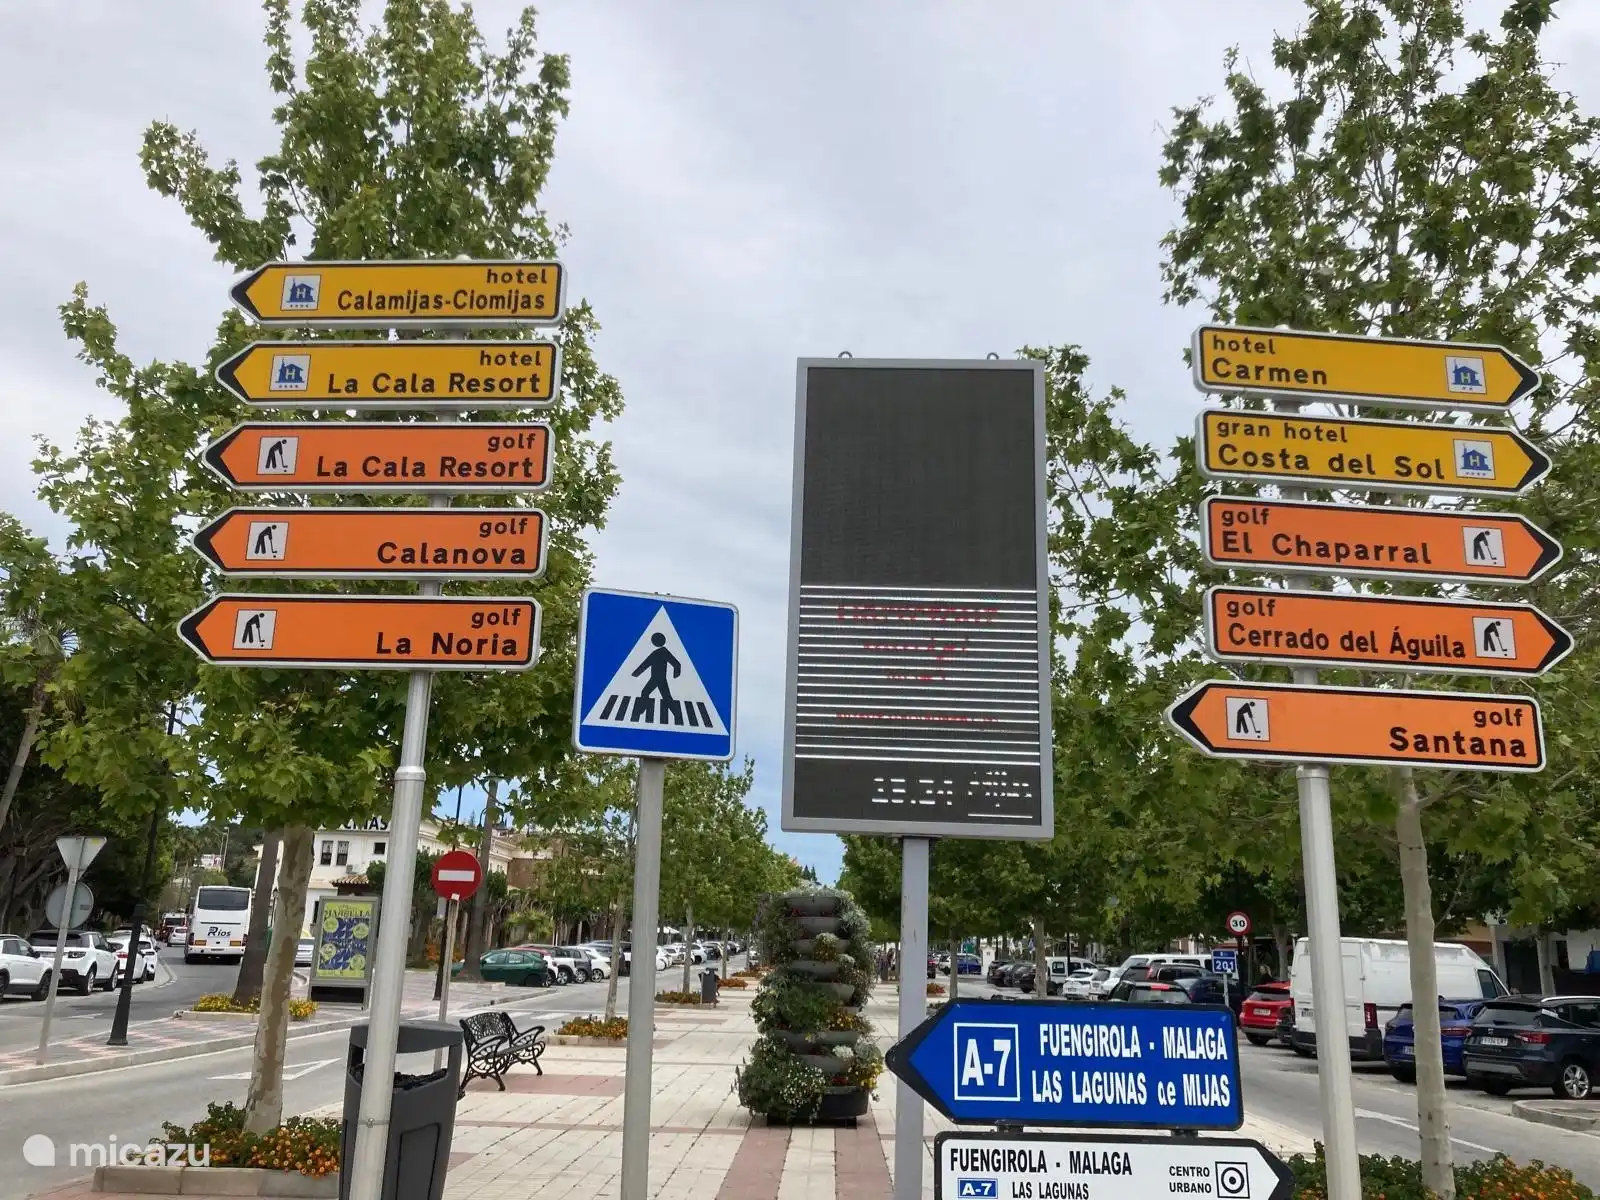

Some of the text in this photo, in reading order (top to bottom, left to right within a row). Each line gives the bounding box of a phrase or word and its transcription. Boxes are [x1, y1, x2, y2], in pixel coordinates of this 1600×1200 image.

[487, 269, 547, 284] hotel
[1214, 335, 1275, 354] hotel
[480, 350, 541, 366] hotel
[1212, 357, 1327, 385] Carmen
[328, 373, 540, 393] La Cala Resort
[1216, 421, 1347, 443] gran hotel
[488, 433, 536, 452] golf
[317, 456, 533, 478] La Cala Resort
[1218, 444, 1444, 480] Costa del Sol
[1222, 508, 1269, 527] golf
[480, 518, 528, 538] golf
[378, 542, 525, 564] Calanova
[1223, 531, 1431, 564] El Chaparral
[1227, 598, 1275, 618] golf
[472, 608, 521, 629] golf
[376, 632, 517, 655] La Noria
[1229, 623, 1466, 661] Cerrado del Águila
[1474, 708, 1522, 728] golf
[1390, 726, 1526, 758] Santana
[1231, 919, 1246, 928] 30
[1215, 960, 1235, 971] 201
[1040, 1024, 1141, 1057] FUENGIROLA
[1163, 1027, 1227, 1060] MALAGA
[962, 1039, 1010, 1086] A-7
[1032, 1071, 1062, 1103] LAS
[1072, 1071, 1147, 1104] LAGUNAS
[1183, 1074, 1230, 1106] MIJAS
[951, 1148, 1047, 1173] FUENGIROLA
[1070, 1151, 1132, 1175] MALAGA
[1169, 1166, 1210, 1177] CENTRO
[962, 1183, 992, 1197] A-7
[1013, 1182, 1089, 1200] LAS LAGUNAS
[1170, 1182, 1211, 1193] URBANO
